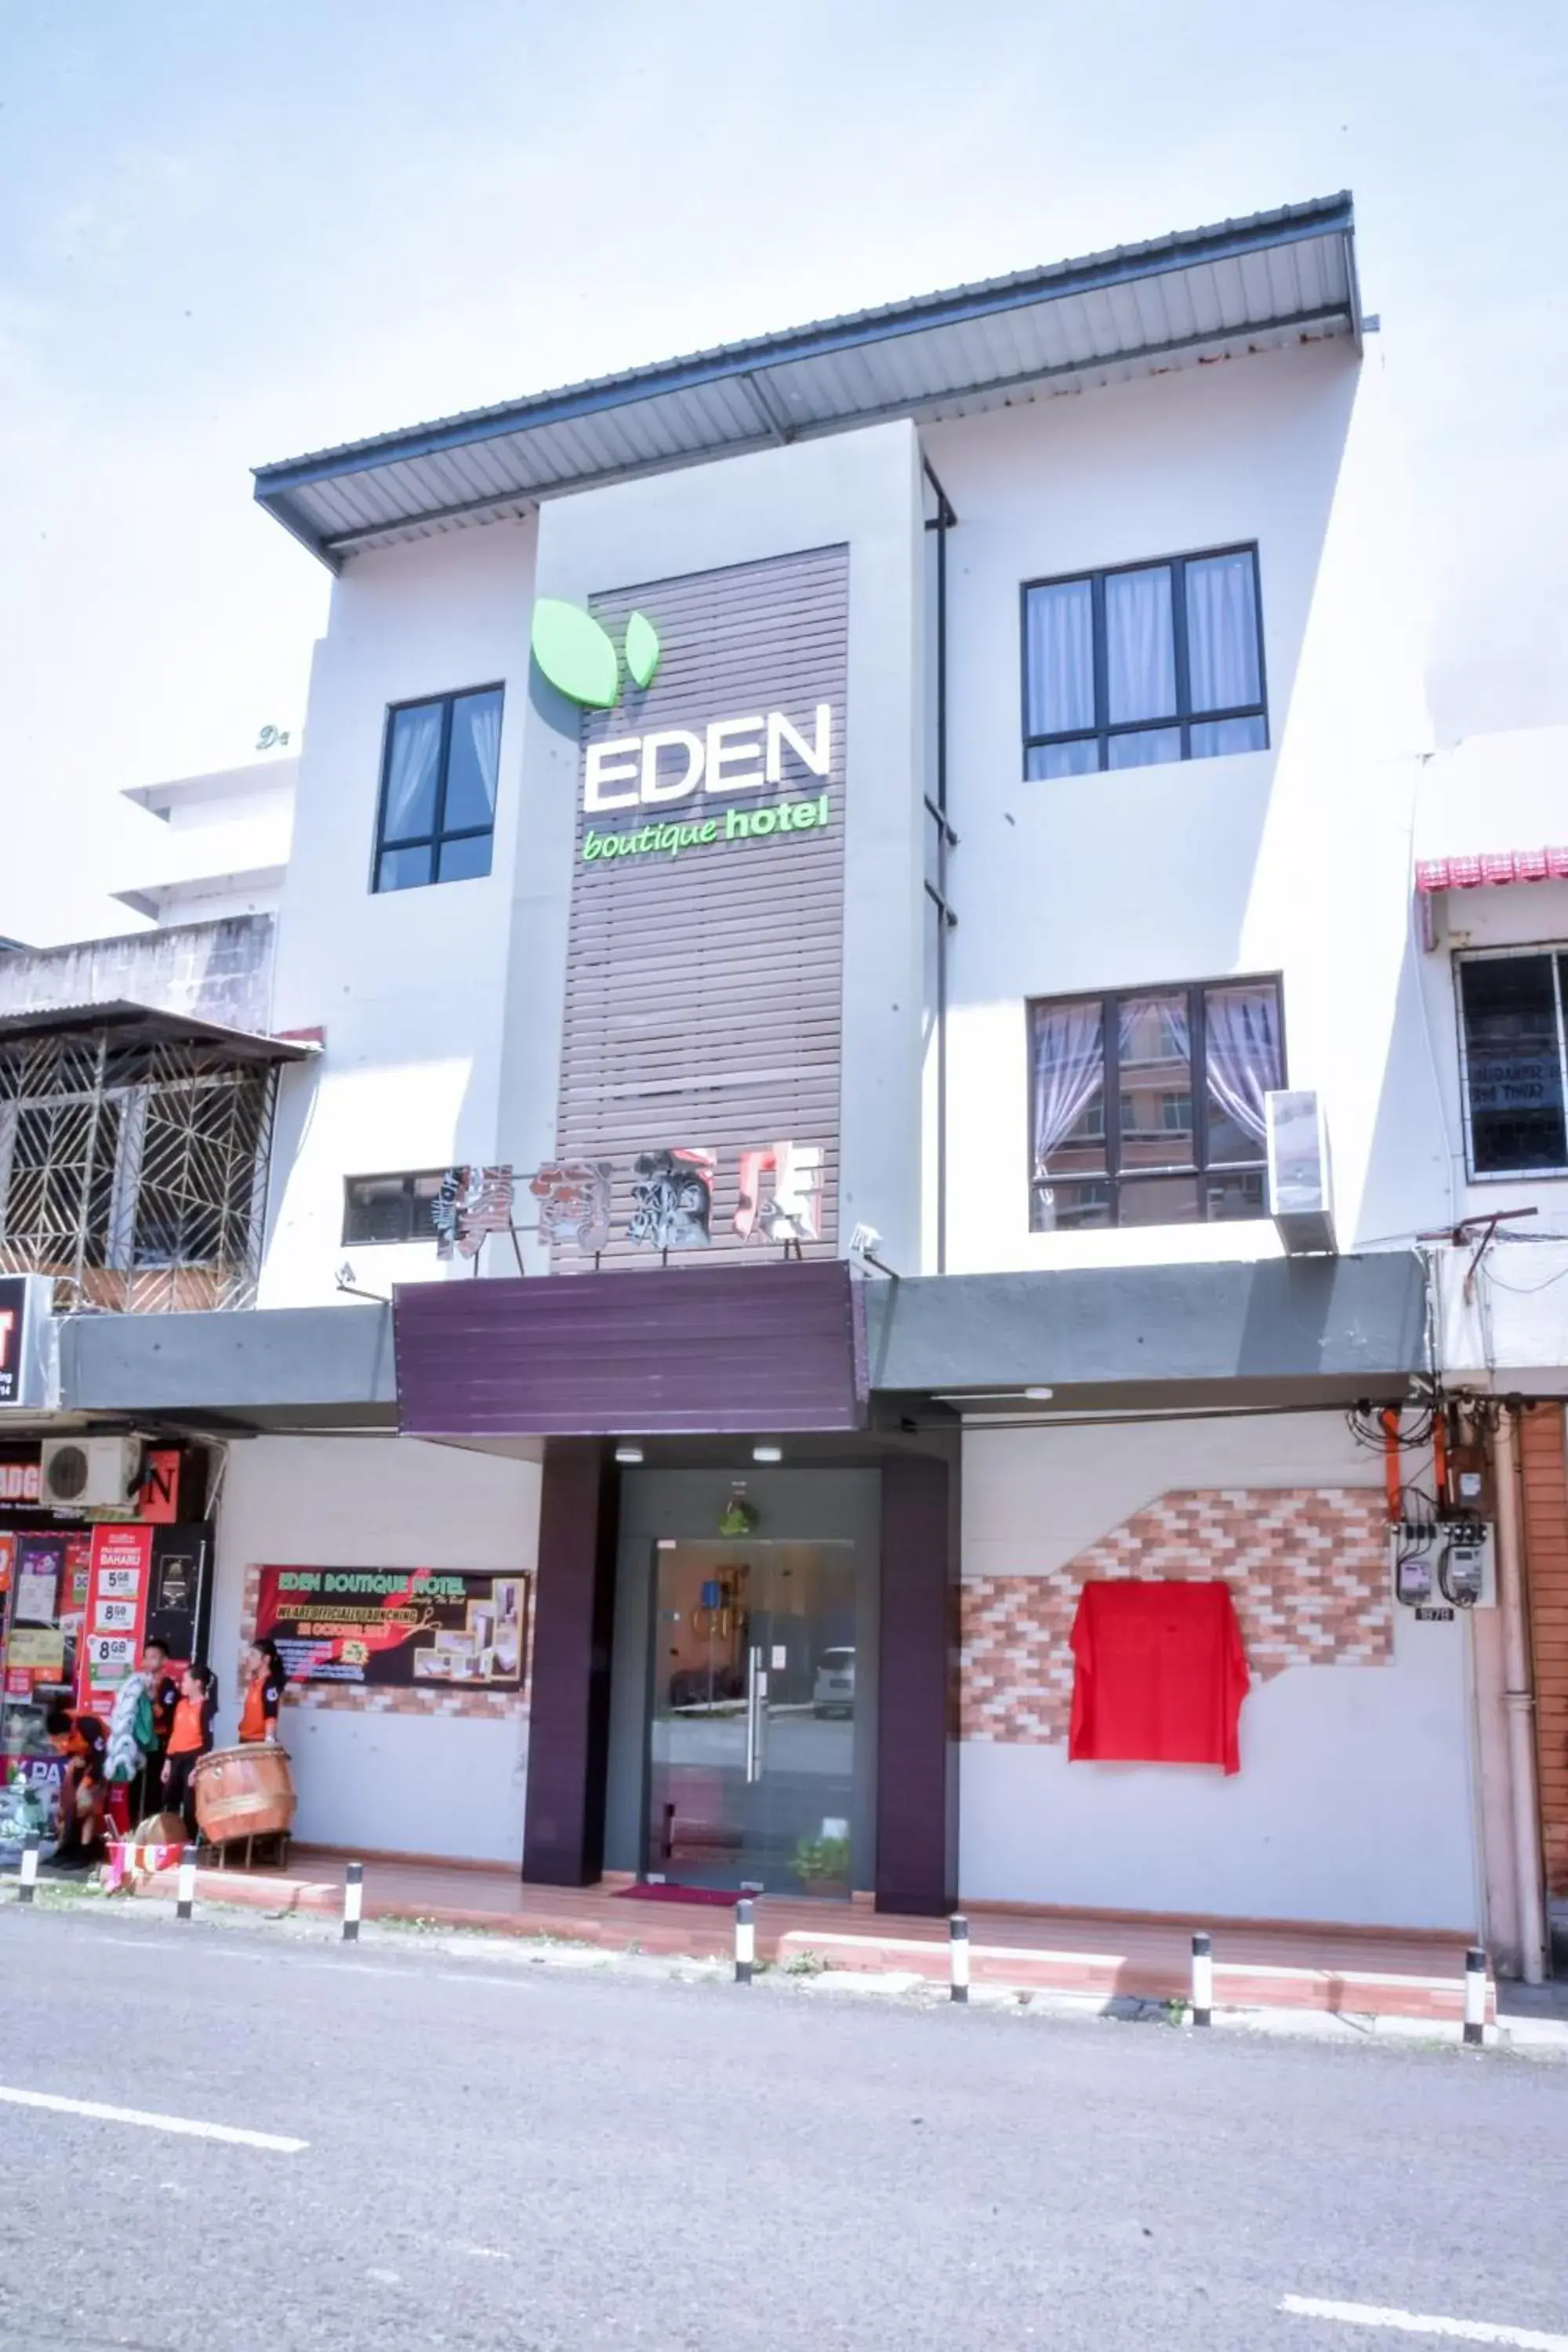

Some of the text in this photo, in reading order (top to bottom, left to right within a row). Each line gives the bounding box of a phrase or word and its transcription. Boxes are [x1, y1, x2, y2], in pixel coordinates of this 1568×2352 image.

[583, 704, 832, 813] EDEN
[583, 795, 829, 861] boutique hotel
[108, 1572, 117, 1587] 5
[278, 1572, 466, 1595] EDEN BOUTIQUE HOTEL
[105, 1605, 114, 1620] 8
[100, 1641, 126, 1660] 8 GB
